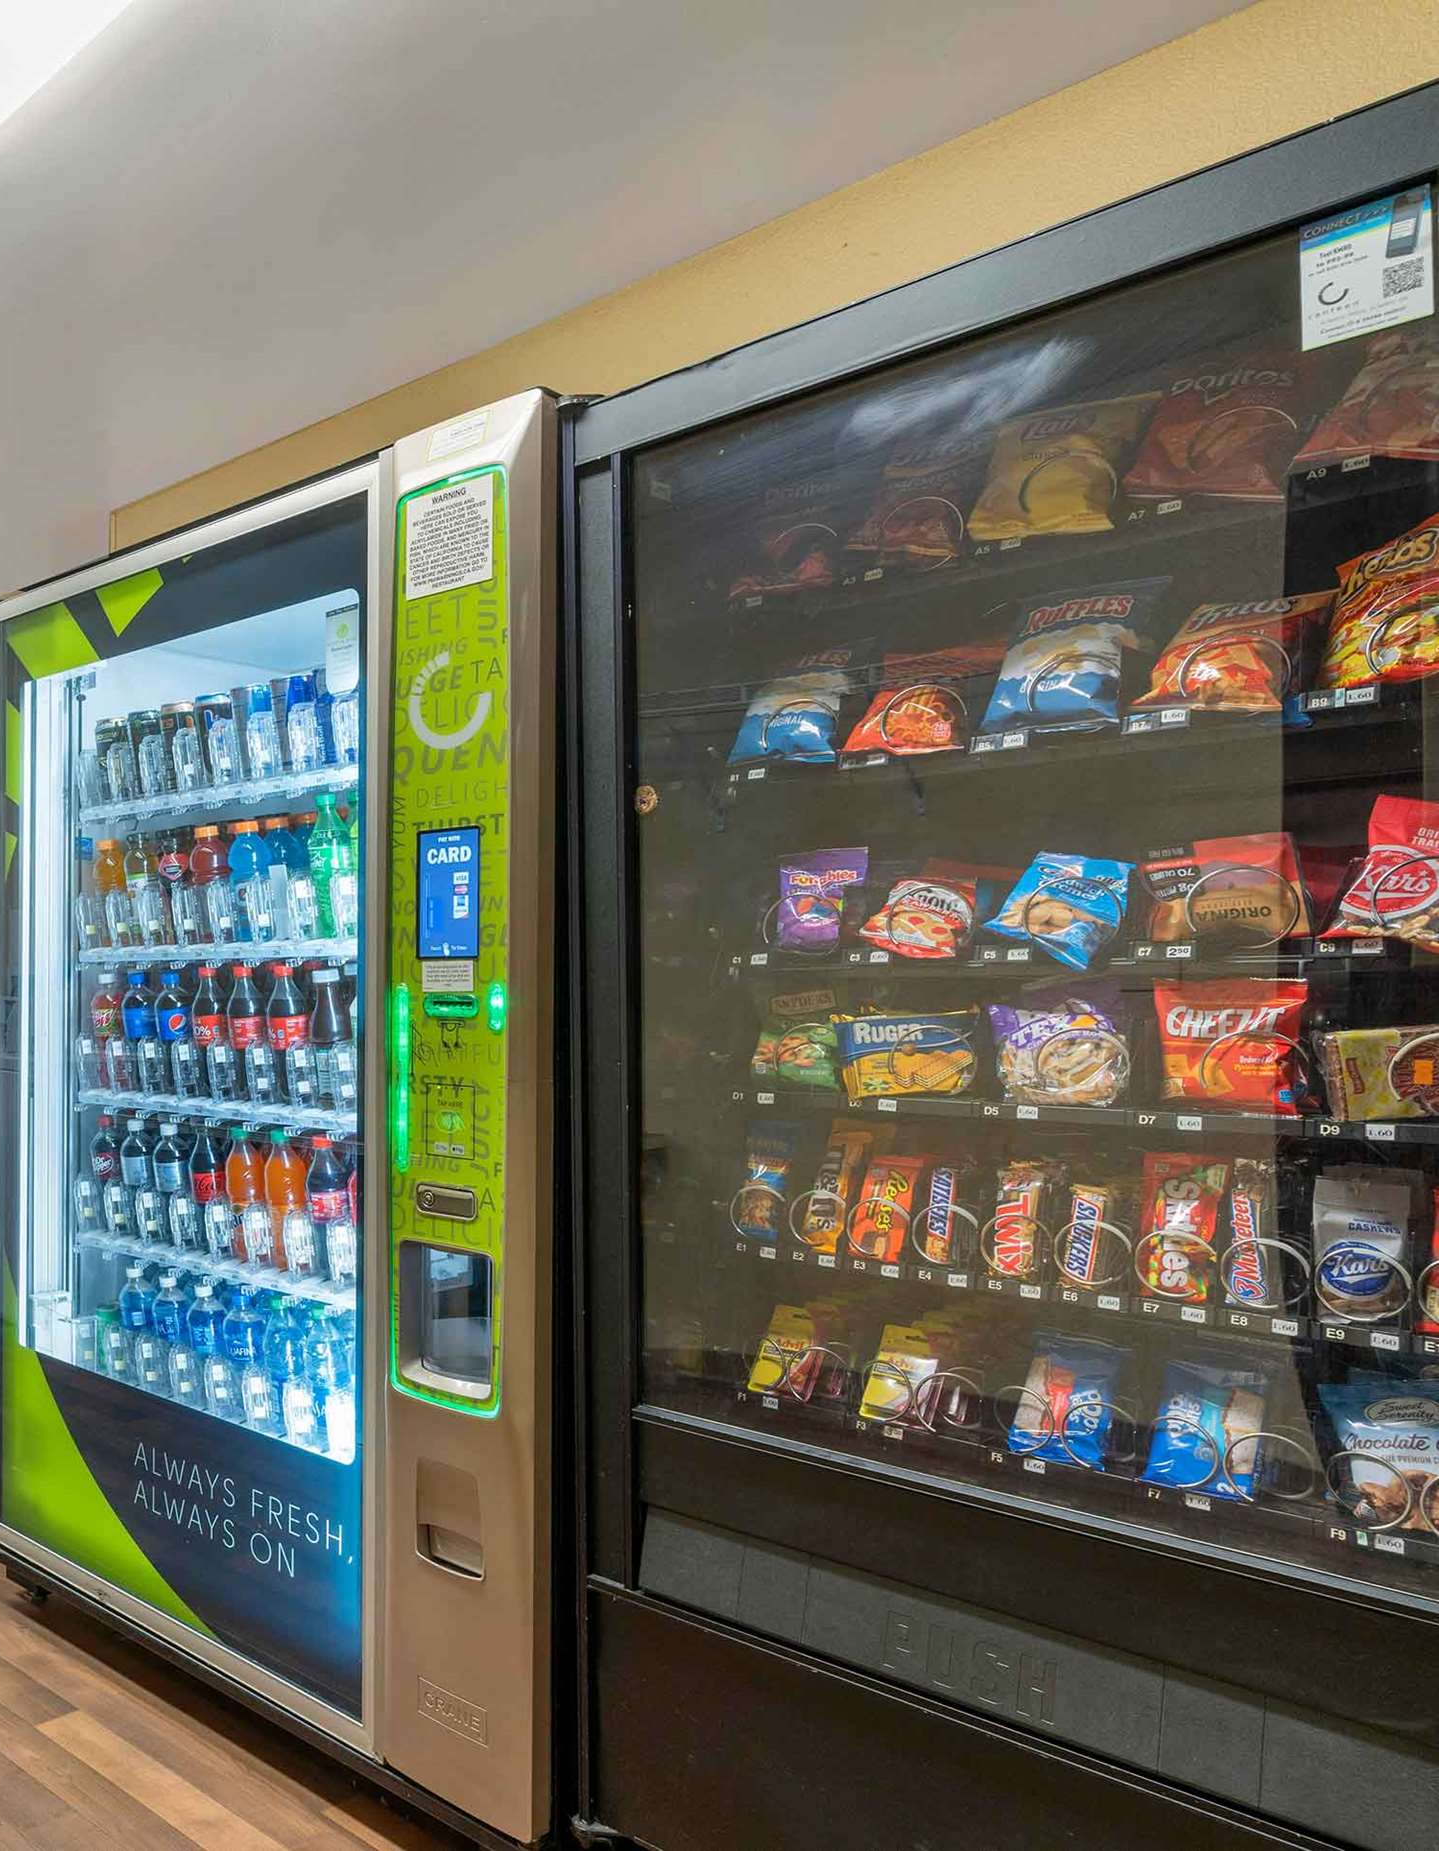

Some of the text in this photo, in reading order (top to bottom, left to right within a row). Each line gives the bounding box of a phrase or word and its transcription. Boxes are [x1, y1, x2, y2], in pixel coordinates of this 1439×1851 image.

[1307, 468, 1327, 480] A9
[432, 487, 466, 504] WARNING
[1128, 510, 1146, 521] A7
[1023, 596, 1133, 637] RUFFLES
[427, 846, 471, 864] CARD
[1195, 905, 1272, 922] ORIGINA
[1137, 947, 1152, 957] C7
[1320, 942, 1336, 953] C9
[984, 950, 996, 960] C5
[853, 1021, 923, 1045] RUGER
[983, 1106, 999, 1116] D5
[1137, 1115, 1156, 1125] D7
[1320, 1125, 1340, 1136] D9
[1348, 1222, 1401, 1234] CASHEWS
[994, 1193, 1031, 1277] TWIX
[1065, 1200, 1098, 1282] SNICKERS
[792, 1251, 805, 1261] E2
[853, 1260, 866, 1270] E3
[918, 1269, 932, 1280] E4
[988, 1280, 1002, 1291] E5
[1062, 1290, 1079, 1302] E6
[1143, 1302, 1160, 1314] E7
[1230, 1315, 1248, 1327] E8
[1326, 1327, 1345, 1340] E9
[1345, 1433, 1431, 1450] Chocolate
[990, 1451, 1004, 1464] F5
[134, 1442, 353, 1564] ALWAYS FRESH,
[134, 1480, 296, 1578] ALWAYS ON
[1330, 1527, 1347, 1541] F9
[424, 1692, 481, 1733] CRANE
